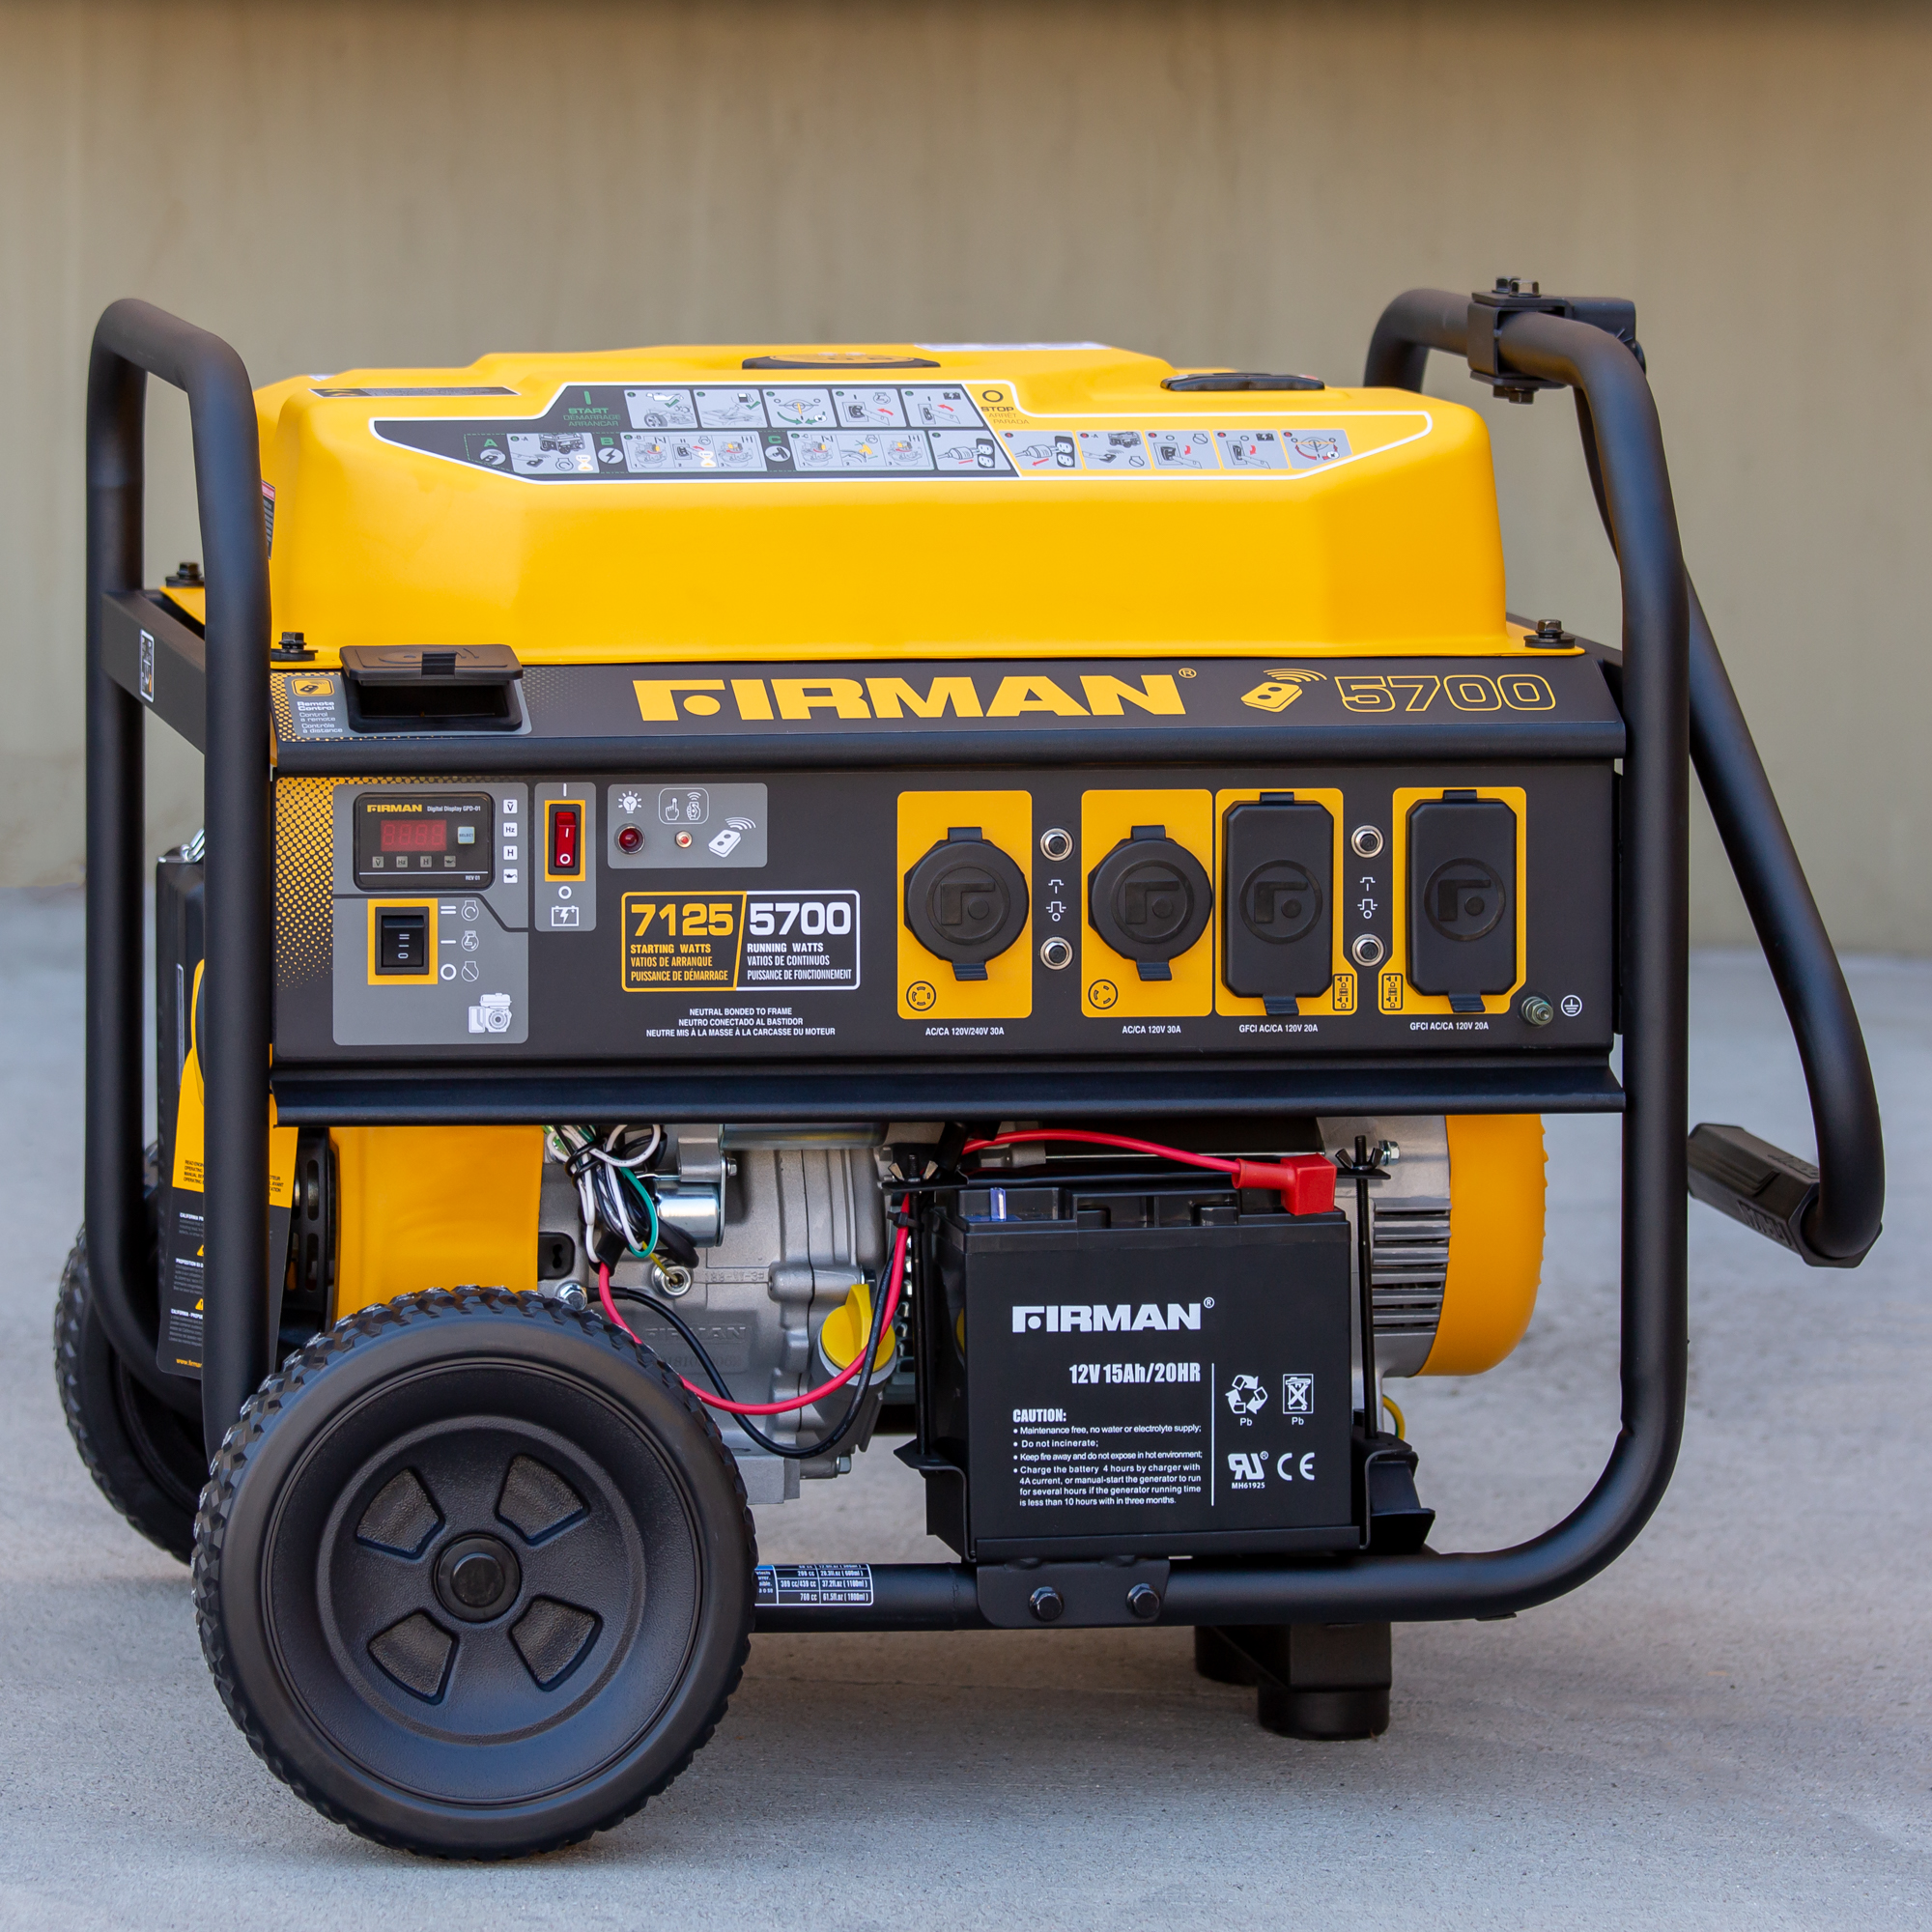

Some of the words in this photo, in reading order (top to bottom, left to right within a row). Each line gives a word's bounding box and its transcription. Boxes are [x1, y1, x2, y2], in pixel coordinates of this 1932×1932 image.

[1334, 674, 1556, 712] 5700
[632, 903, 733, 936] 7125
[750, 902, 851, 935] 5700
[631, 944, 674, 953] STARTING
[680, 944, 711, 953] WATTS
[748, 943, 786, 952] RUNNING
[792, 943, 823, 952] WATTS
[631, 956, 657, 967] VATIOS
[660, 956, 669, 967] DE
[671, 956, 712, 967] ARRANQUE
[748, 955, 773, 966] VATIOS
[775, 955, 784, 965] DE
[787, 955, 830, 965] CONTINUOS
[631, 971, 670, 981] PUISSANCE
[672, 971, 682, 980] DE
[684, 968, 728, 980] DÉMARRAGE
[748, 970, 782, 980] PUISSANCE
[784, 970, 792, 980] DE
[794, 969, 851, 980] FONCTIONNEMENT
[690, 1027, 696, 1037] À
[735, 1026, 740, 1036] À
[952, 1027, 988, 1036] 120V/240V
[1167, 1025, 1180, 1034] 30A
[1259, 1024, 1283, 1033] AC/CA
[1069, 1364, 1100, 1383] 12V
[1103, 1363, 1200, 1383] 15Ah/20HR
[1013, 1408, 1066, 1422] CAUTION:
[1134, 1425, 1173, 1434] electrolyte
[1020, 1466, 1051, 1475] Charge
[1069, 1465, 1098, 1474] battery
[1137, 1464, 1147, 1473] by
[1149, 1464, 1181, 1474] charger
[1277, 1452, 1315, 1481] CE
[1032, 1477, 1063, 1486] current,
[1110, 1487, 1150, 1495] generator
[1151, 1486, 1181, 1495] running
